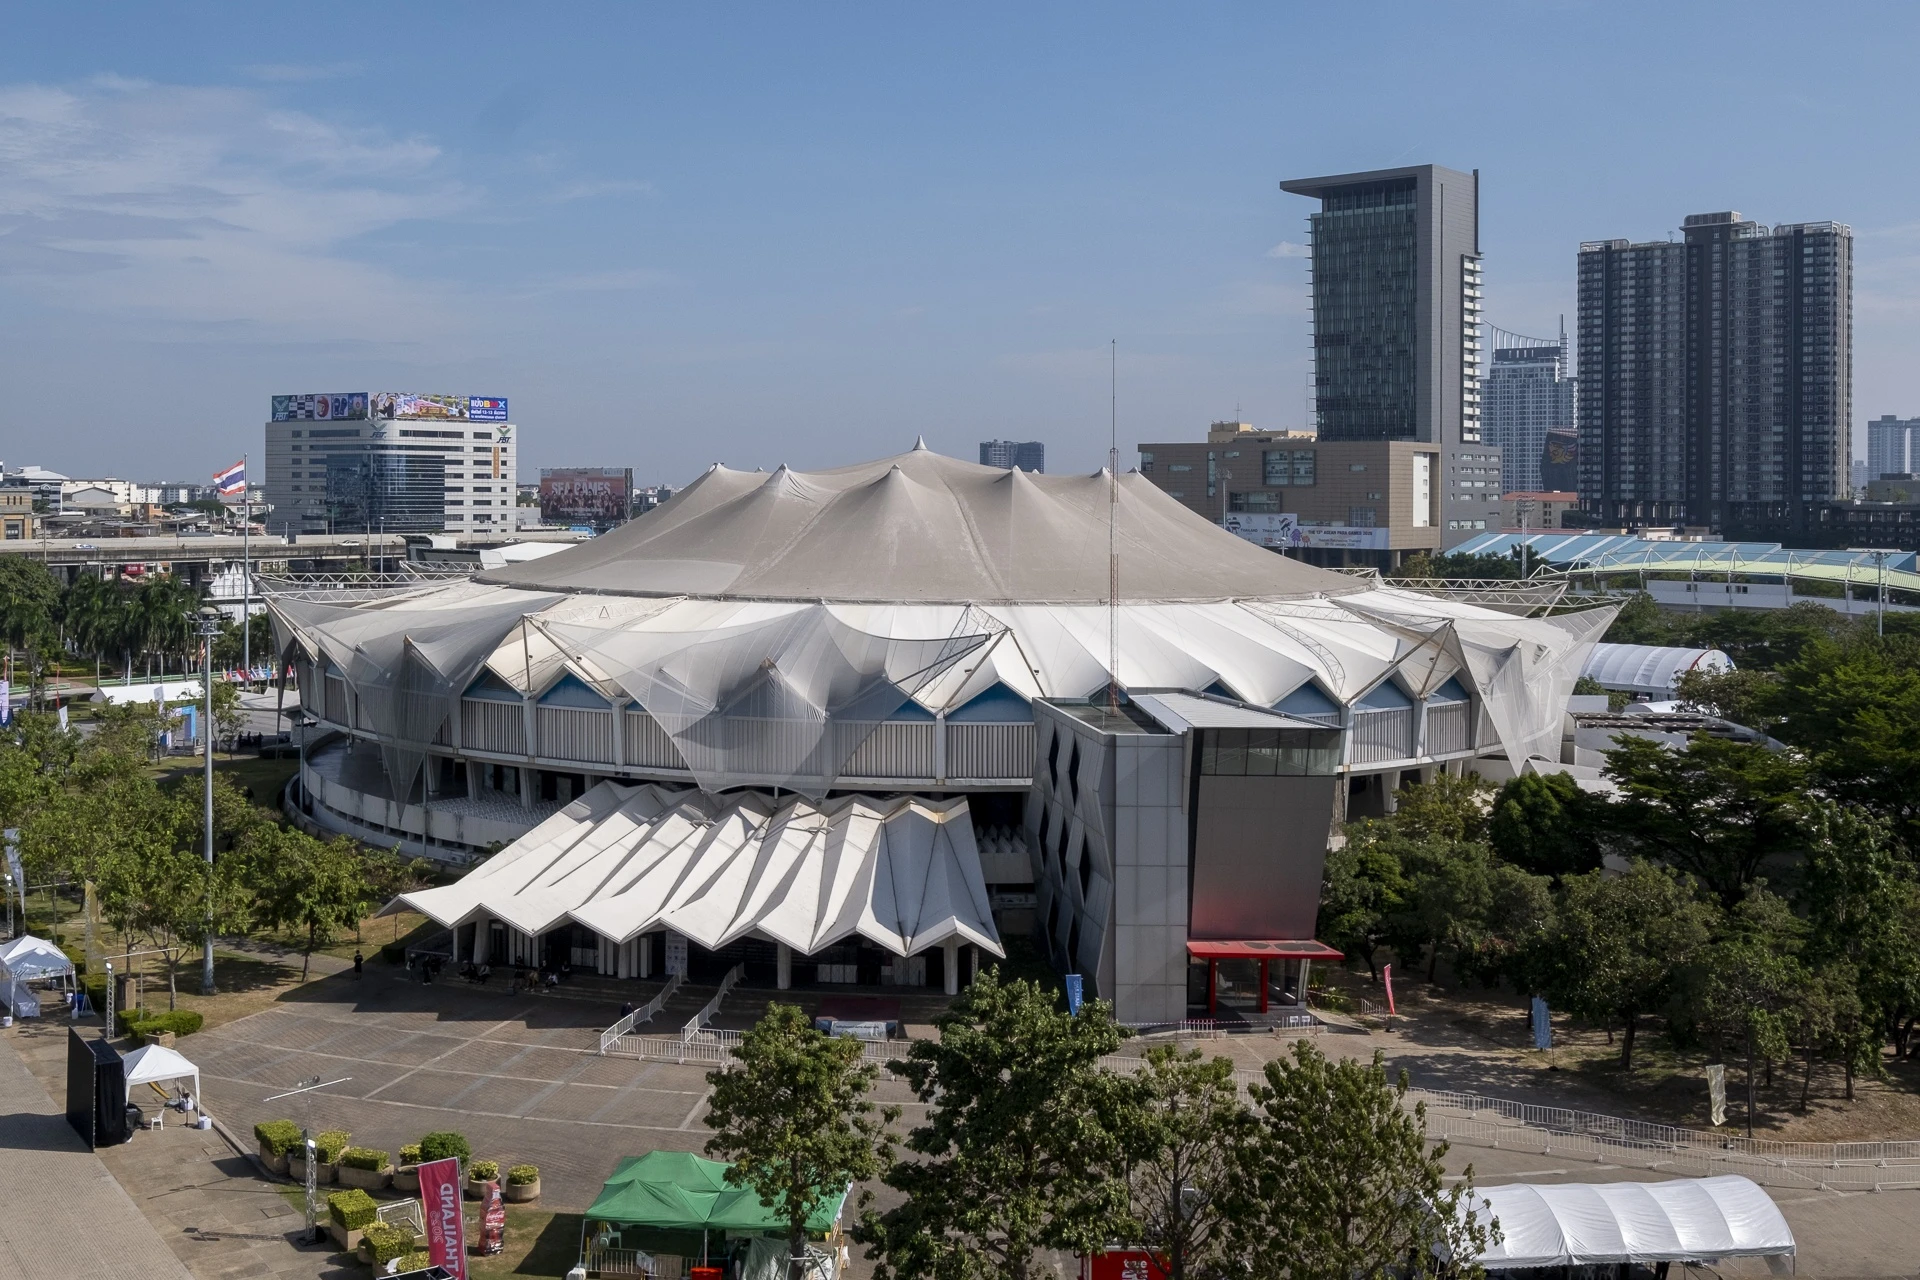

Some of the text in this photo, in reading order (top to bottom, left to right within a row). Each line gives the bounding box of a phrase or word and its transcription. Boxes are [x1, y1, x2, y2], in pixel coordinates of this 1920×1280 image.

[273, 412, 288, 420] FBT
[552, 482, 610, 496] SEA GAMES
